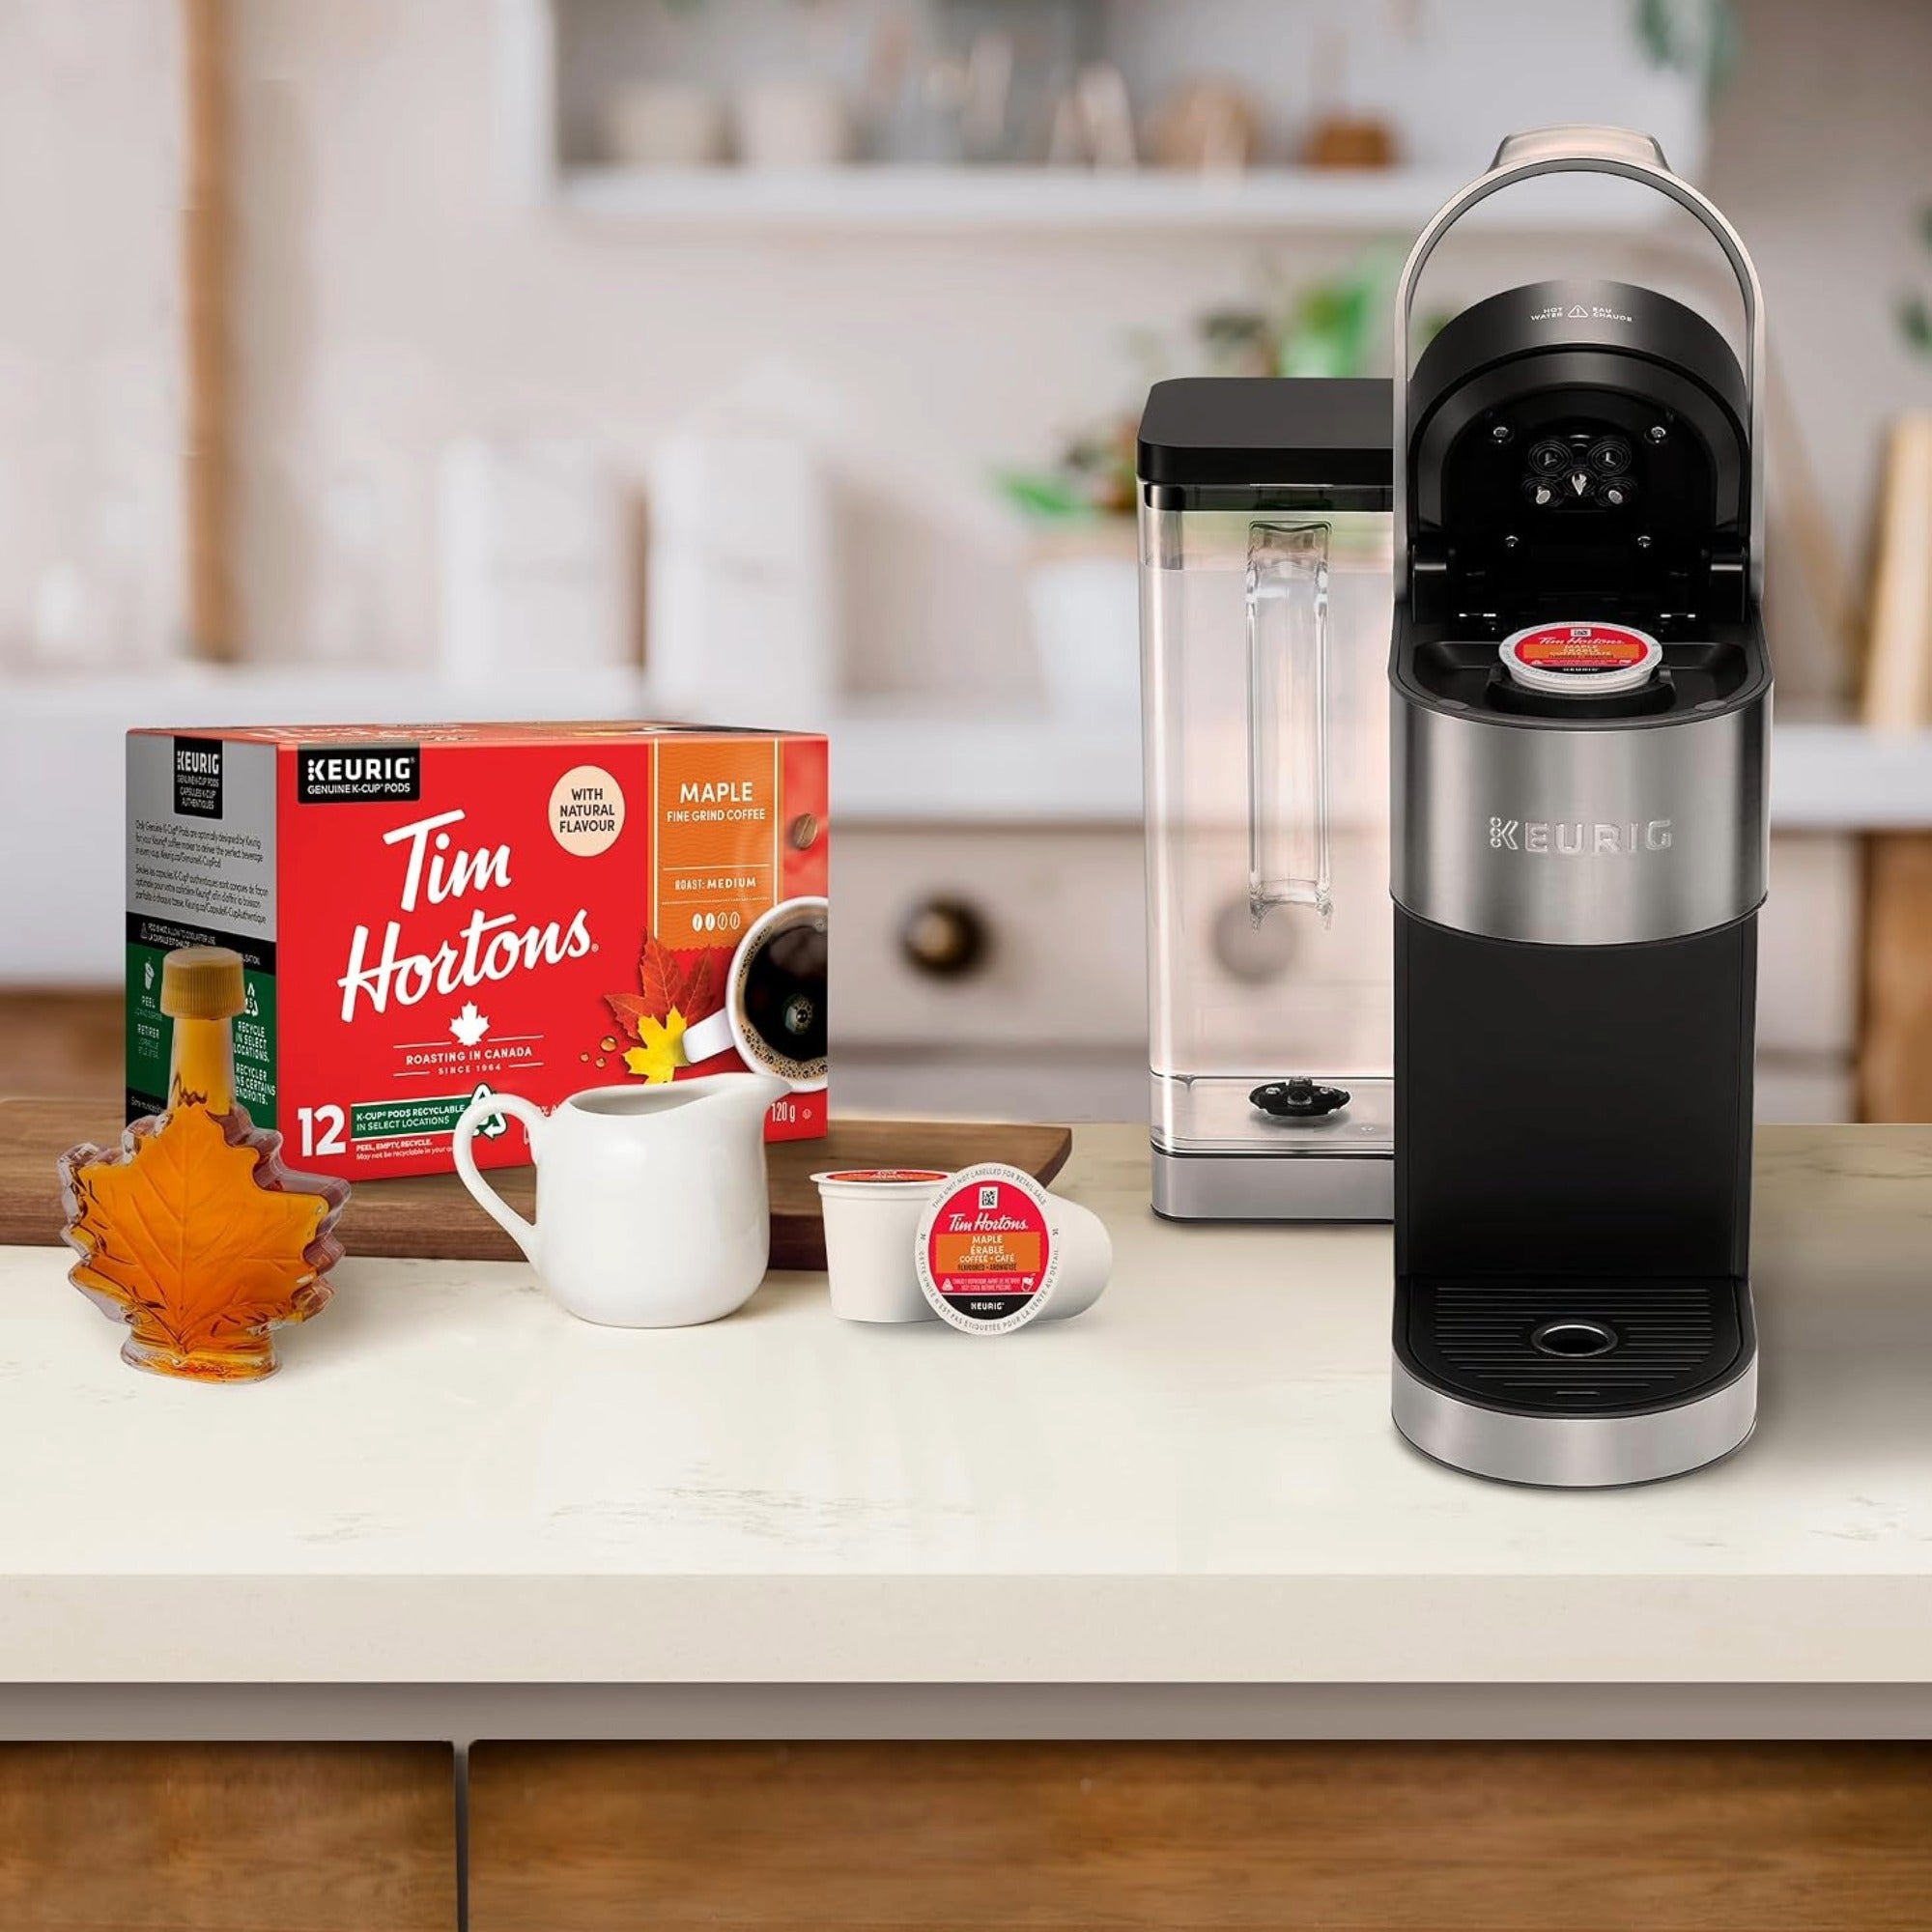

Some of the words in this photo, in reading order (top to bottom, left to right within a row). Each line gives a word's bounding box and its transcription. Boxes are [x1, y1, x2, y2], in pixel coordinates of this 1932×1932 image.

[1530, 311, 1563, 321] WATER
[1592, 312, 1633, 323] CHAUDE
[307, 784, 352, 795] GENUINE
[384, 782, 411, 793] PODS
[571, 788, 603, 801] WITH
[679, 781, 753, 804] MAPLE
[559, 804, 615, 818] NATURAL
[667, 810, 690, 822] FINE
[692, 810, 724, 821] GRIND
[726, 808, 766, 820] COFFEE
[559, 820, 615, 834] FLAVOUR
[1490, 817, 1672, 853] KEURIG
[383, 809, 512, 913] Tim
[674, 879, 705, 891] ROAST:
[706, 877, 756, 889] MEDIUM
[238, 1020, 265, 1038] RECYCLE
[243, 1035, 268, 1050] SELECT
[406, 1051, 466, 1065] ROASTING
[469, 1050, 481, 1061] IN
[484, 1046, 532, 1060] CANADA
[236, 1063, 267, 1081] RECYCLER
[438, 1065, 471, 1075] SINCE
[475, 1063, 501, 1072] 1964
[245, 1077, 276, 1096] CERTAINS
[387, 1109, 411, 1120] PODS
[412, 1104, 465, 1117] RECYCLABLE
[771, 1101, 787, 1122] 120
[789, 1104, 796, 1123] g
[297, 1103, 347, 1157] 12
[356, 1122, 366, 1131] IN
[367, 1121, 401, 1130] SELECT
[402, 1116, 449, 1128] LOCATIONS
[393, 1147, 424, 1157] recyclable
[432, 1147, 445, 1155] your
[1003, 1168, 1015, 1178] FOR
[1033, 1188, 1047, 1206] SALE
[949, 1212, 974, 1232] Tim
[972, 1235, 1003, 1244] MAPLE
[970, 1243, 1005, 1255] ÉRABLE
[959, 1255, 988, 1264] COFFEE
[995, 1252, 1015, 1263] CAFÉ
